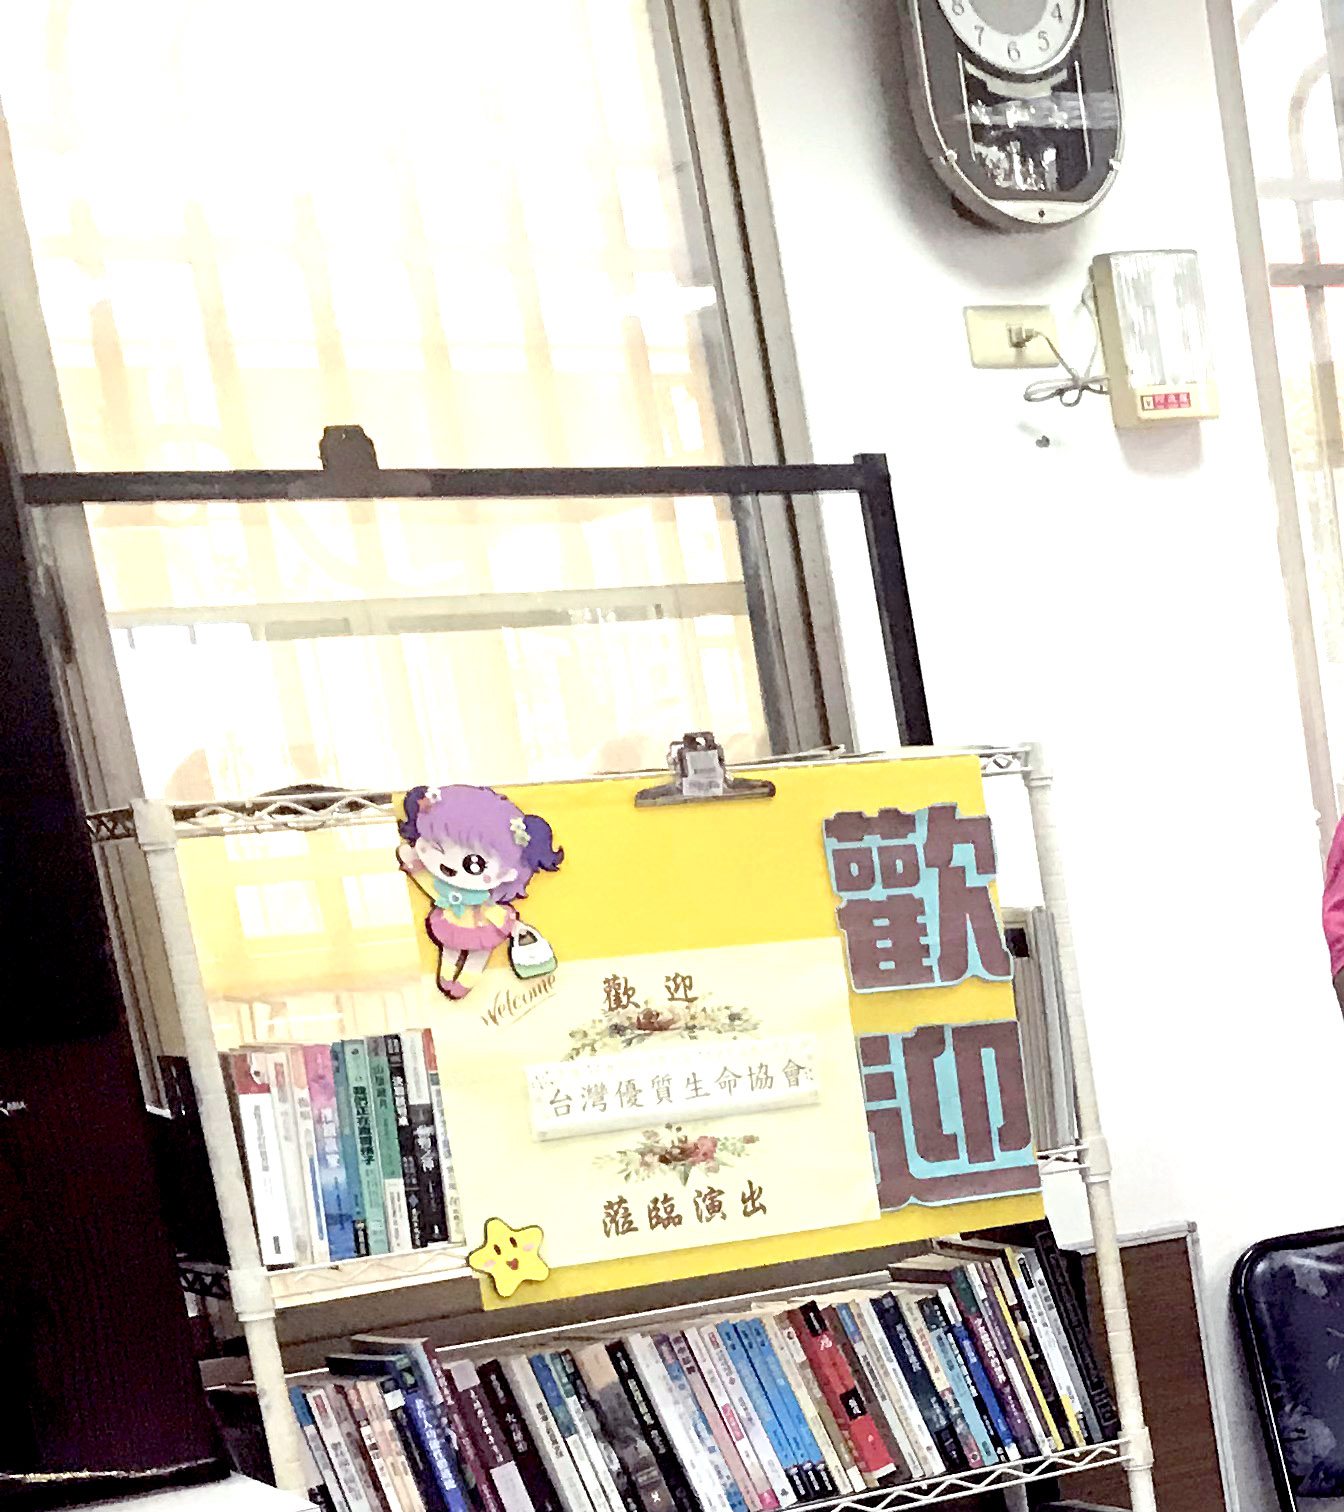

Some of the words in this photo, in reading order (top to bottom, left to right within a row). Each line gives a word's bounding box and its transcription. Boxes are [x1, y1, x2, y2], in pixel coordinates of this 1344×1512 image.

[1050, 2, 1063, 24] 4
[974, 24, 985, 47] 7
[1006, 40, 1021, 62] 6
[1037, 30, 1050, 52] 5
[602, 972, 699, 1012] 歡迎
[821, 802, 1041, 1211] 歡迎
[549, 1058, 806, 1117] 台灣優質生命協會
[601, 1179, 767, 1238] 蒞臨演出
